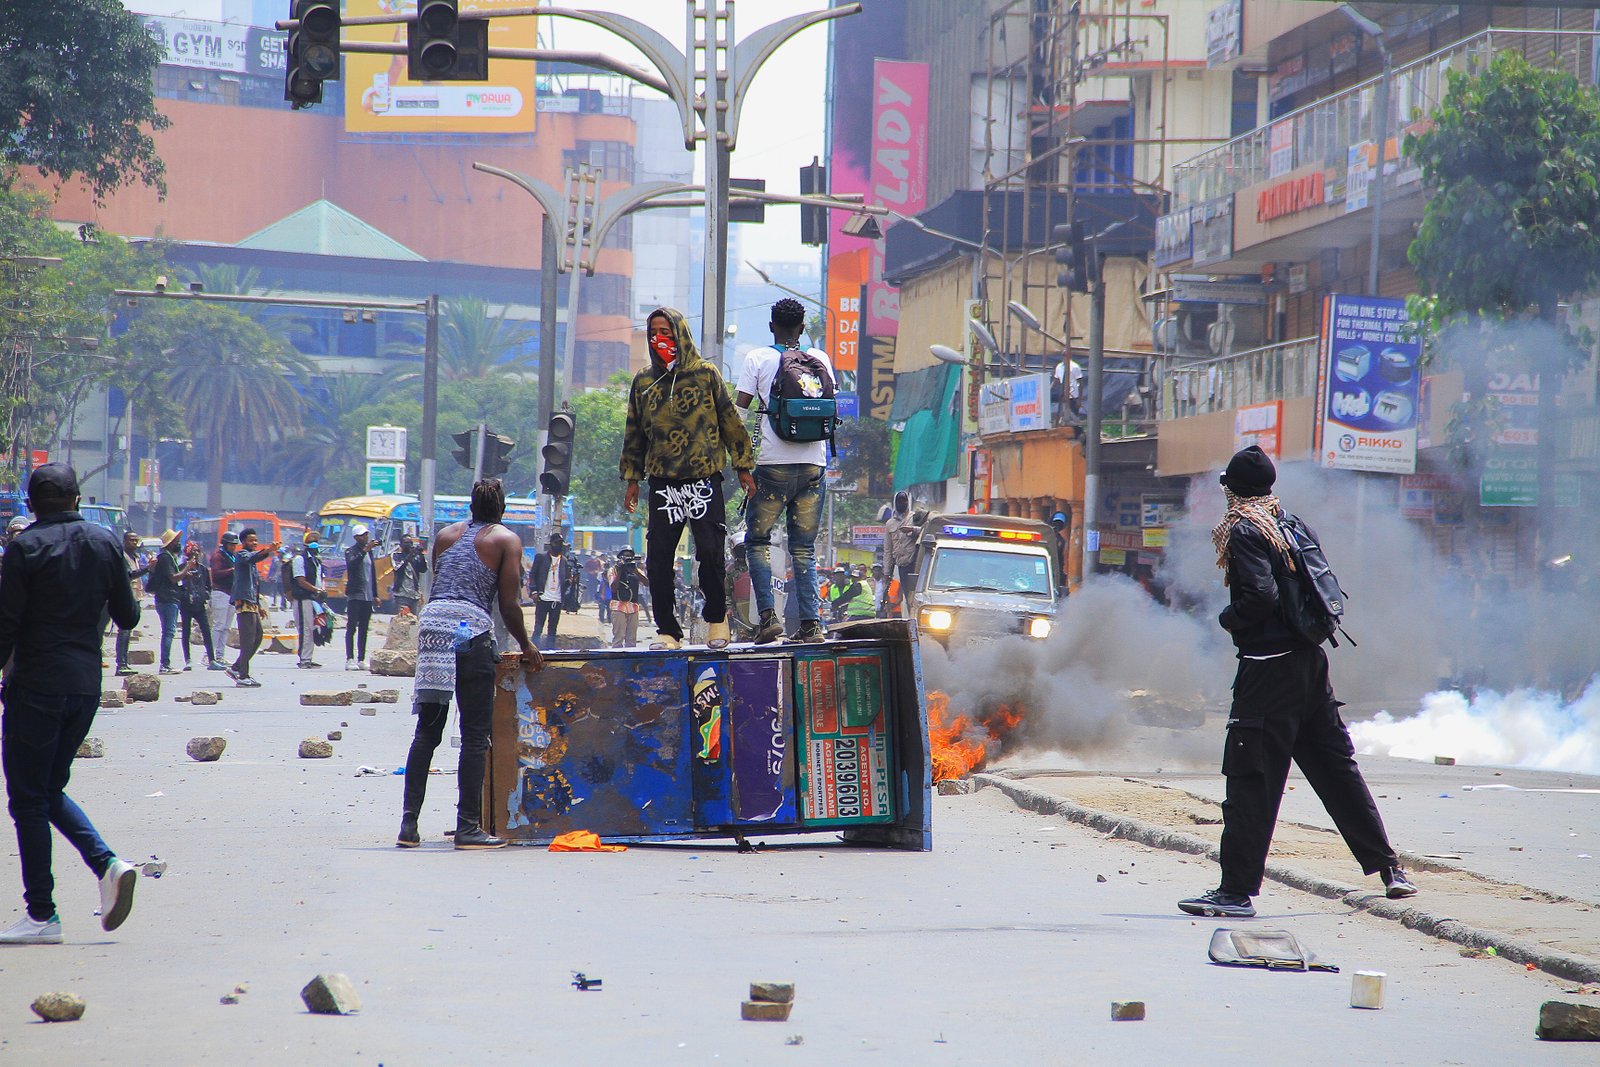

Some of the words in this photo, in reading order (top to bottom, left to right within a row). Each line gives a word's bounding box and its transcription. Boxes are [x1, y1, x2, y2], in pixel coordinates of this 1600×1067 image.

[183, 24, 212, 32] MODERN
[173, 32, 222, 59] GYM
[1338, 304, 1359, 317] YOUR
[1360, 305, 1375, 318] ONE
[1377, 306, 1397, 320] STOP
[1336, 330, 1356, 341] ROLLS
[1362, 332, 1384, 342] MONEY
[1337, 318, 1351, 329] FOR
[1352, 320, 1383, 332] THERMAL
[1357, 437, 1403, 449] RIKKO
[813, 666, 821, 688] LINES
[814, 689, 824, 728] AVAILABLE
[825, 741, 834, 781] AGENT
[859, 745, 869, 784] AGENT
[835, 738, 859, 817] 2039603
[809, 804, 814, 814] ID
[827, 781, 836, 816] NAME
[863, 785, 871, 810] NO.
